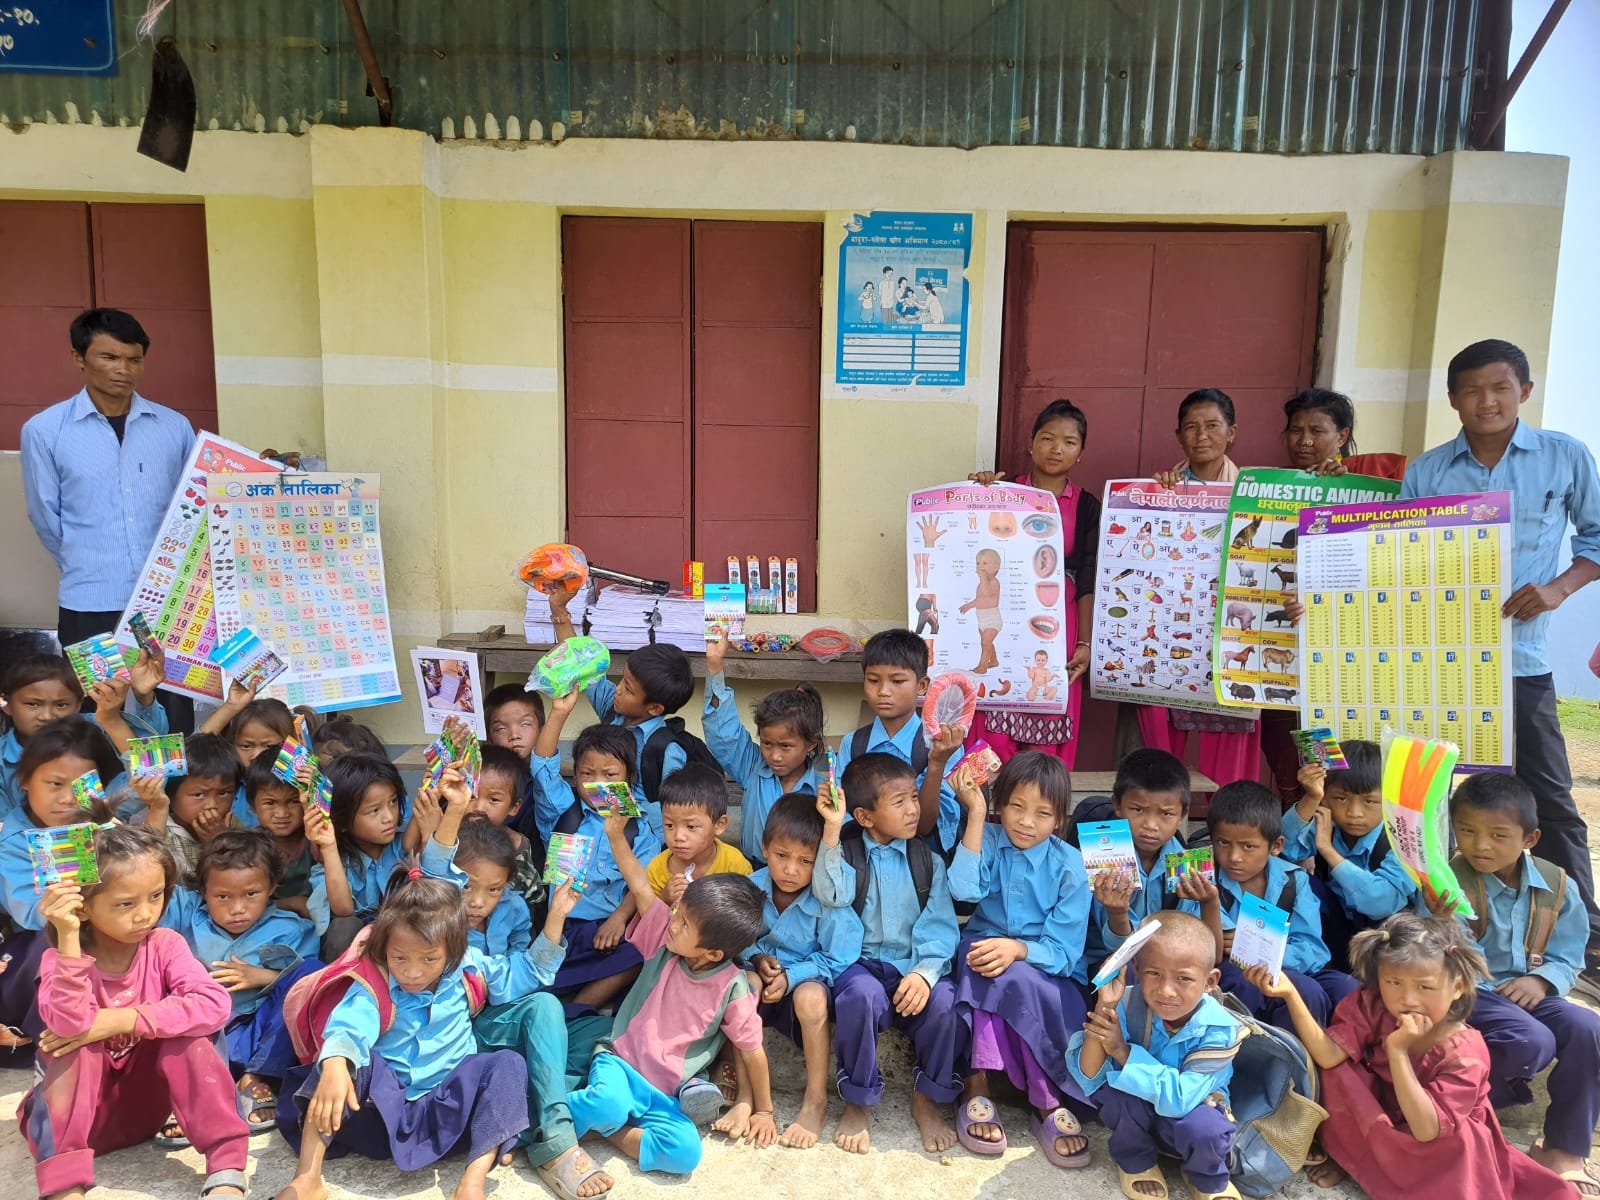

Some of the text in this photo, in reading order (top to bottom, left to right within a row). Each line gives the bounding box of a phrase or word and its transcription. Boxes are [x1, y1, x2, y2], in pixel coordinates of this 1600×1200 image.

[225, 458, 247, 472] Public
[245, 479, 341, 497] अंक तालिका
[1236, 482, 1324, 503] DOMESTIC
[914, 497, 939, 506] Public
[945, 489, 1026, 505] Parts of Body
[1129, 488, 1178, 508] नेपाली
[1331, 505, 1469, 524] MULTIPLICATION TABLE
[197, 531, 205, 542] 4
[191, 548, 197, 557] 5
[184, 564, 190, 573] 6
[197, 568, 208, 579] 16
[177, 581, 184, 591] 7
[190, 585, 201, 595] 17
[170, 597, 177, 607] 8
[183, 601, 195, 612] 18
[197, 605, 209, 616] 28
[163, 614, 170, 624] 9
[176, 618, 188, 629] 19
[189, 622, 202, 634] 29
[204, 626, 217, 638] 39
[154, 629, 166, 642] 10
[167, 634, 180, 646] 20
[182, 638, 195, 650] 30
[197, 643, 210, 654] 40
[176, 655, 202, 666] ROMAN
